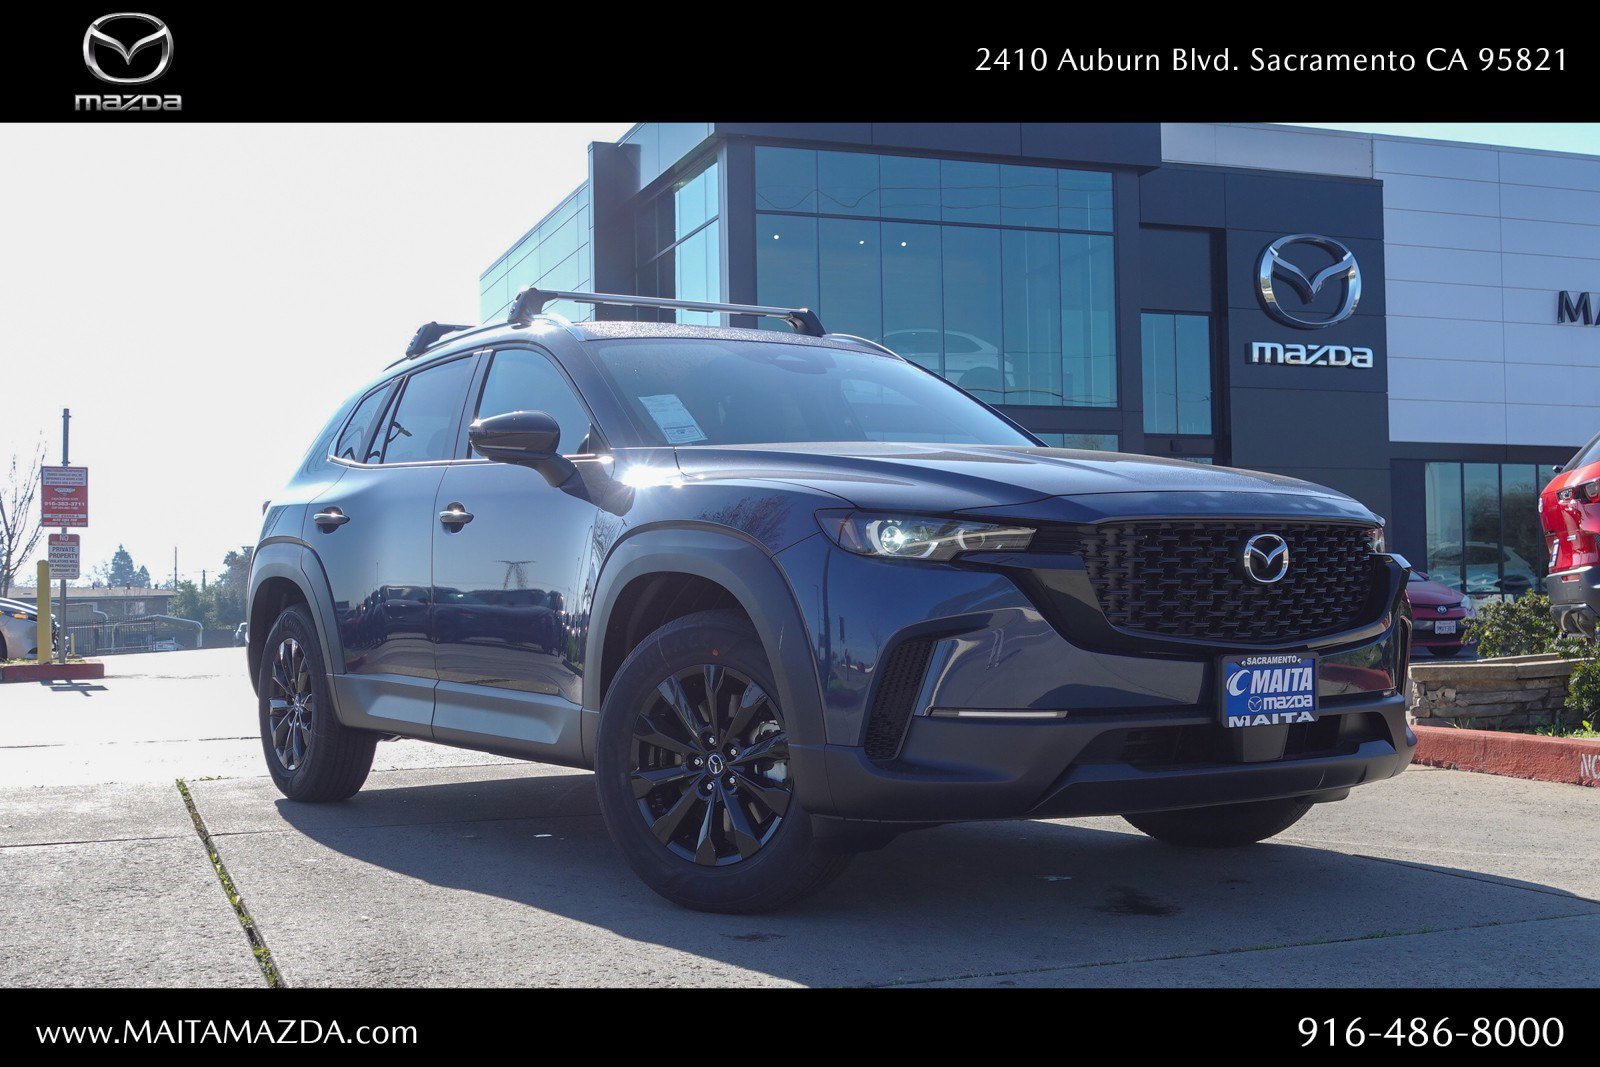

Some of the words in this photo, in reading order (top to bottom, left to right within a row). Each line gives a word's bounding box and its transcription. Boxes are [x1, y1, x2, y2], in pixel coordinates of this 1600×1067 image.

[1557, 290, 1600, 326] M
[60, 534, 69, 542] NO
[1246, 655, 1298, 666] SACRAMENTO
[1250, 667, 1313, 695] MAITA
[1228, 710, 1315, 728] MAITA
